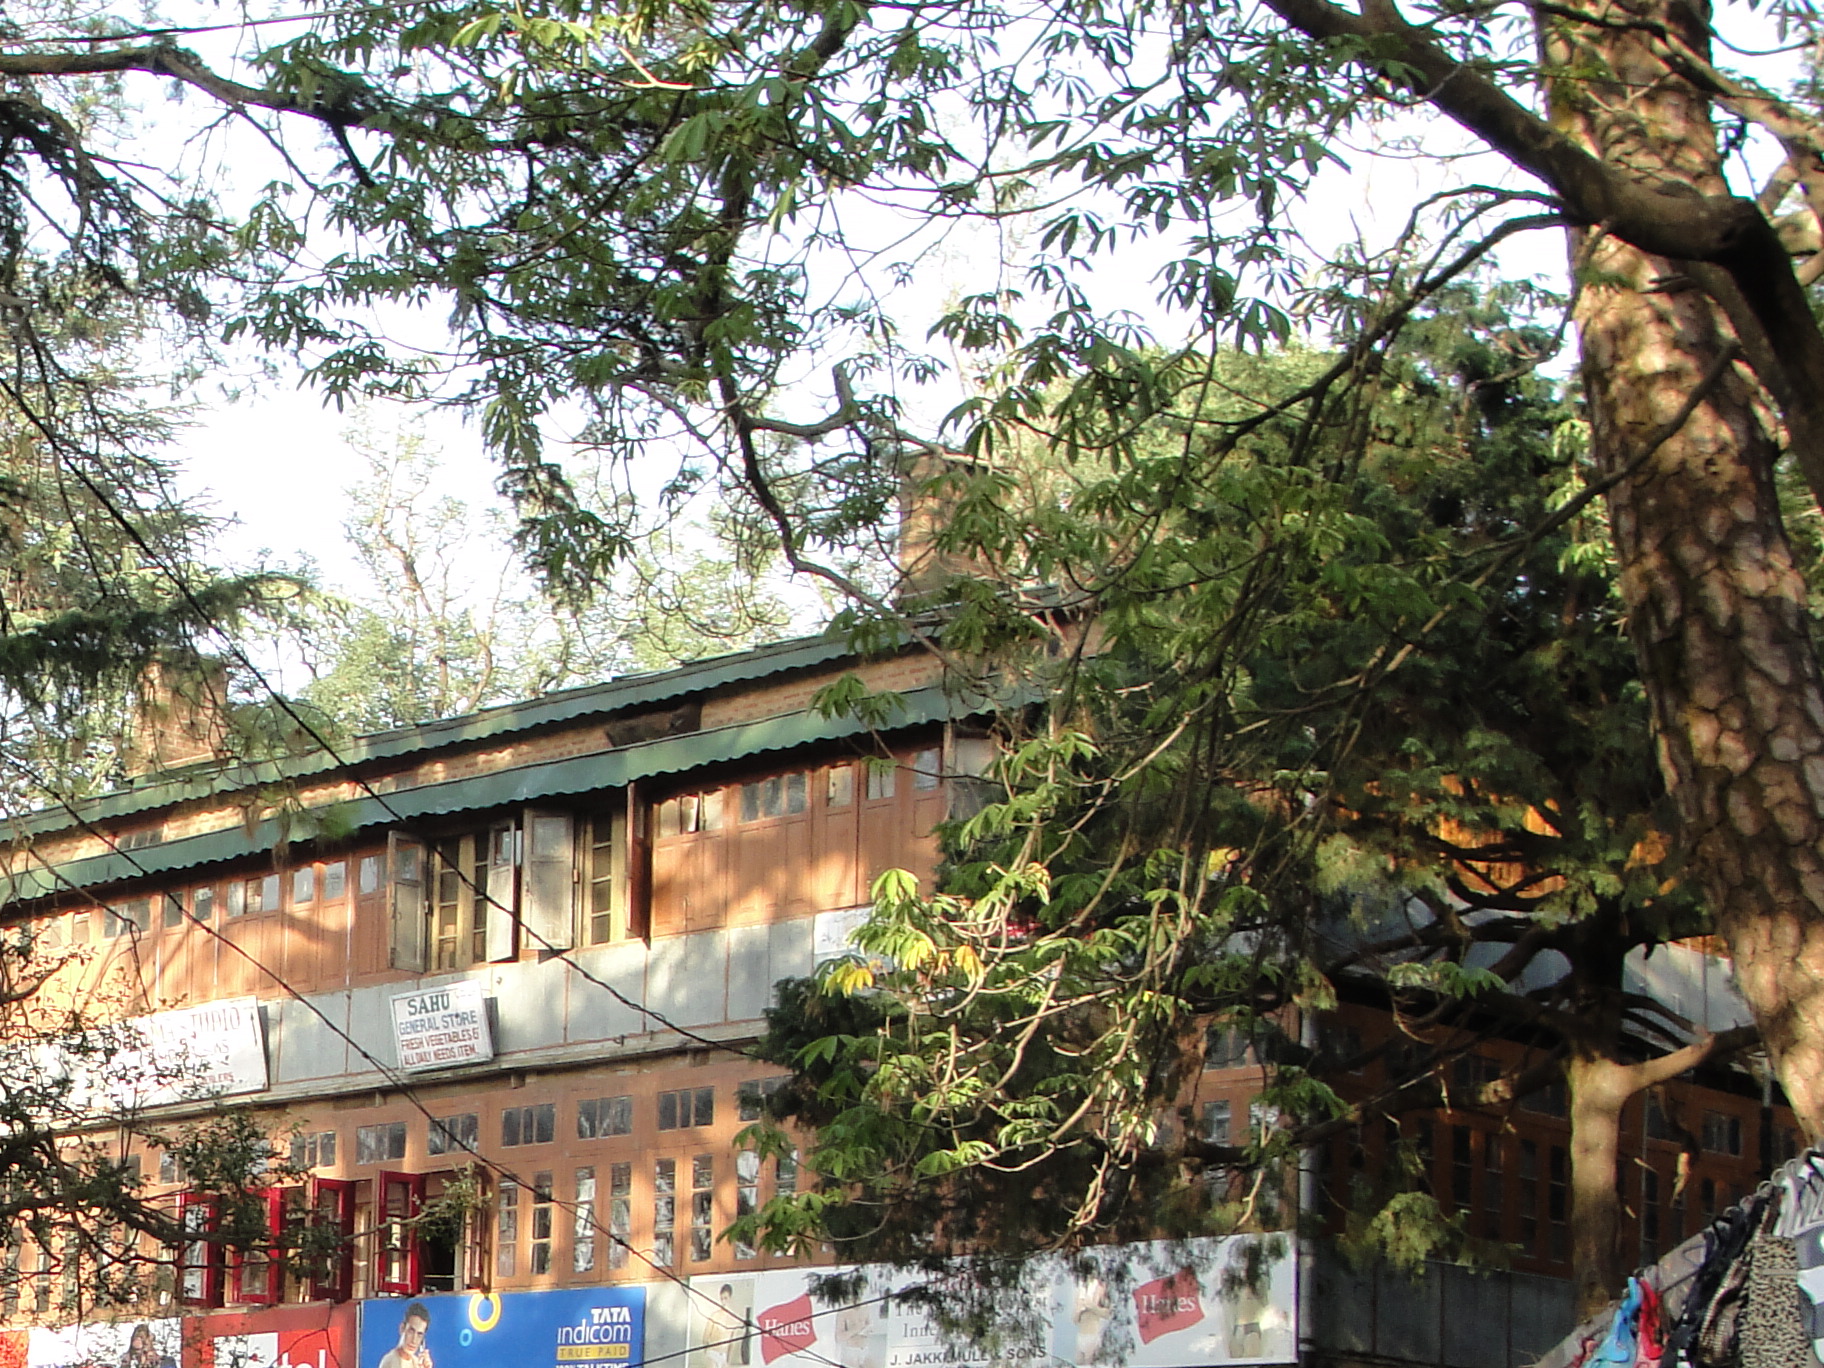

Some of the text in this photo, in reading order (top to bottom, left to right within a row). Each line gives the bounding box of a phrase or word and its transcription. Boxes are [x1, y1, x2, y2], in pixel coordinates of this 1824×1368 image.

[407, 993, 450, 1016] SAHU
[398, 1010, 478, 1036] GENERAL STORE
[401, 1037, 424, 1051] FRESH
[425, 1029, 472, 1047] VEGETABLES
[433, 1047, 456, 1060] NEEDS
[590, 1306, 632, 1324] TATA
[556, 1318, 632, 1345] indicom
[764, 1317, 811, 1341] Hanes
[559, 1345, 627, 1358] TRUE PAID
[889, 1354, 902, 1366] J.
[1006, 1346, 1048, 1360] SONS
